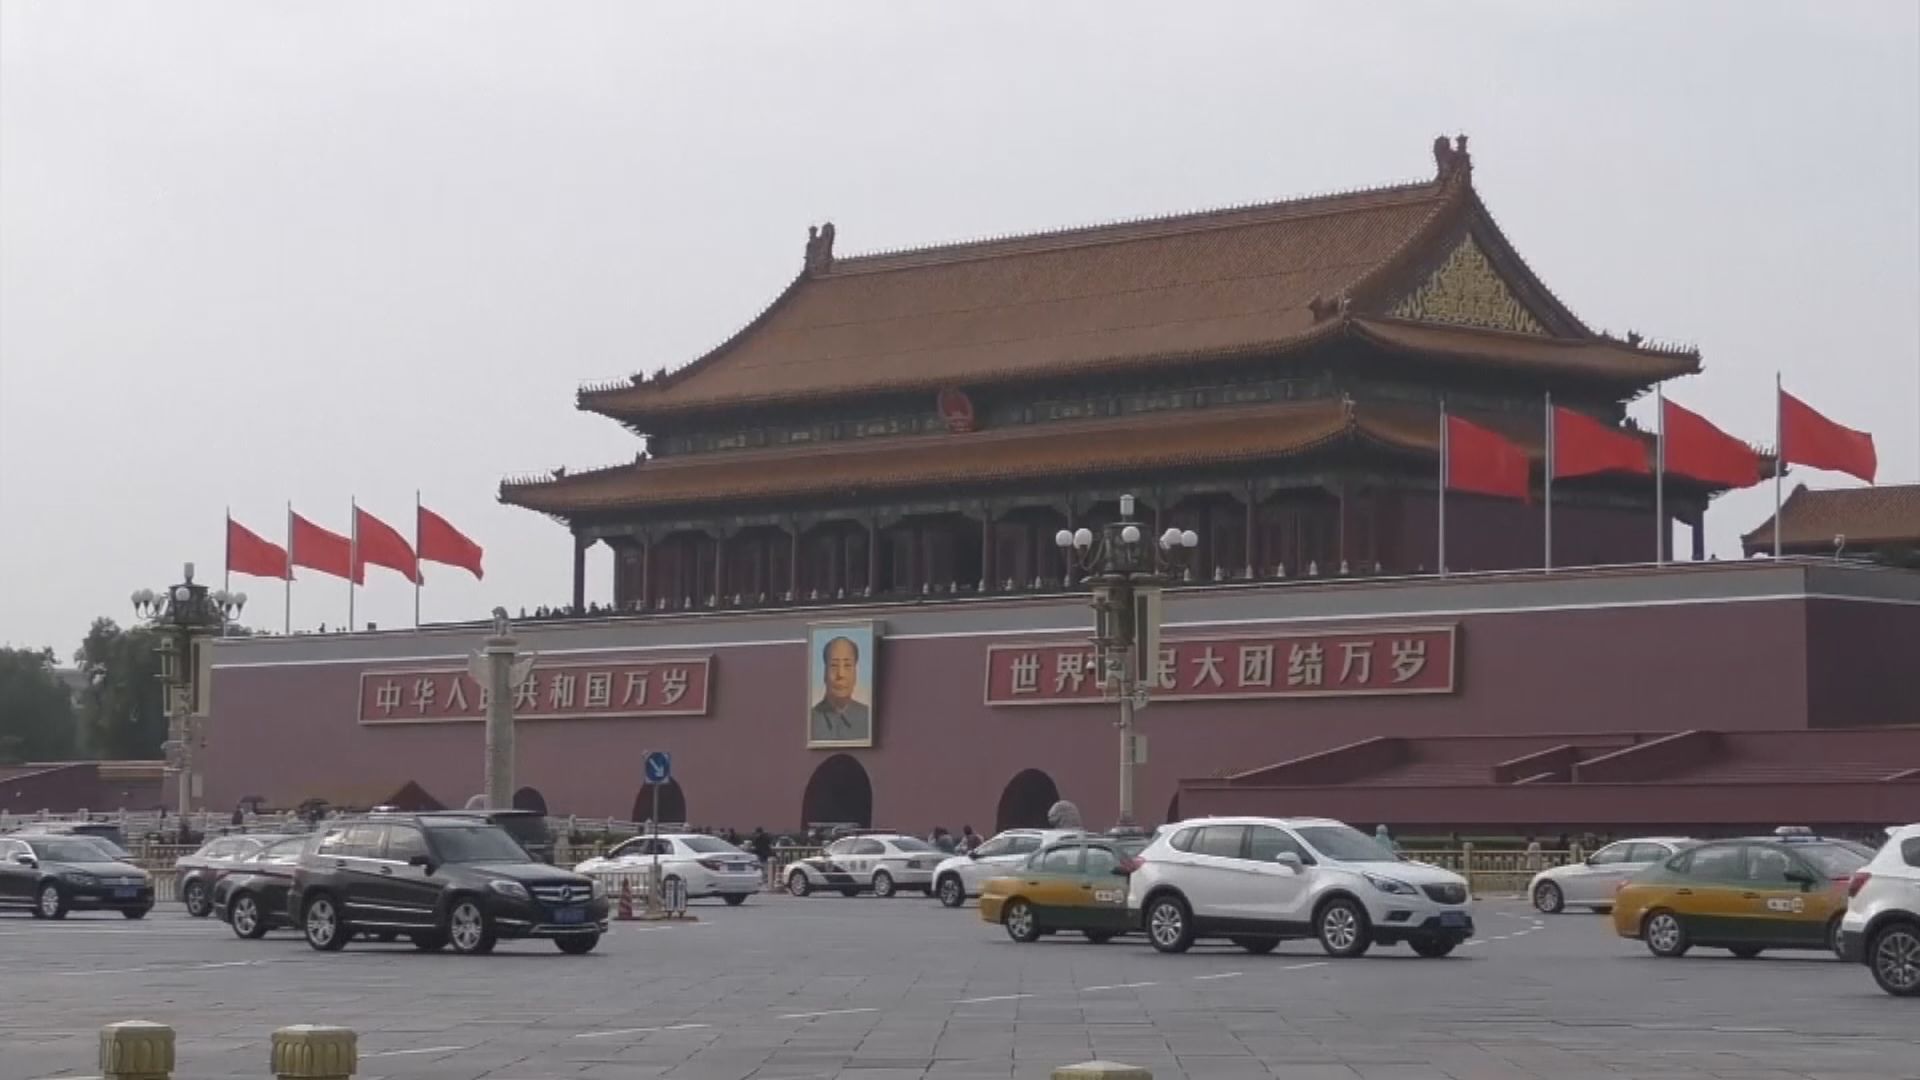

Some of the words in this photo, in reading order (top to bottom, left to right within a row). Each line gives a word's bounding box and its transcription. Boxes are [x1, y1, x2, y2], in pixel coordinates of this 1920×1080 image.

[375, 667, 689, 714] 中华人共和国万岁
[1009, 639, 1427, 693] 世界民大团结万岁
